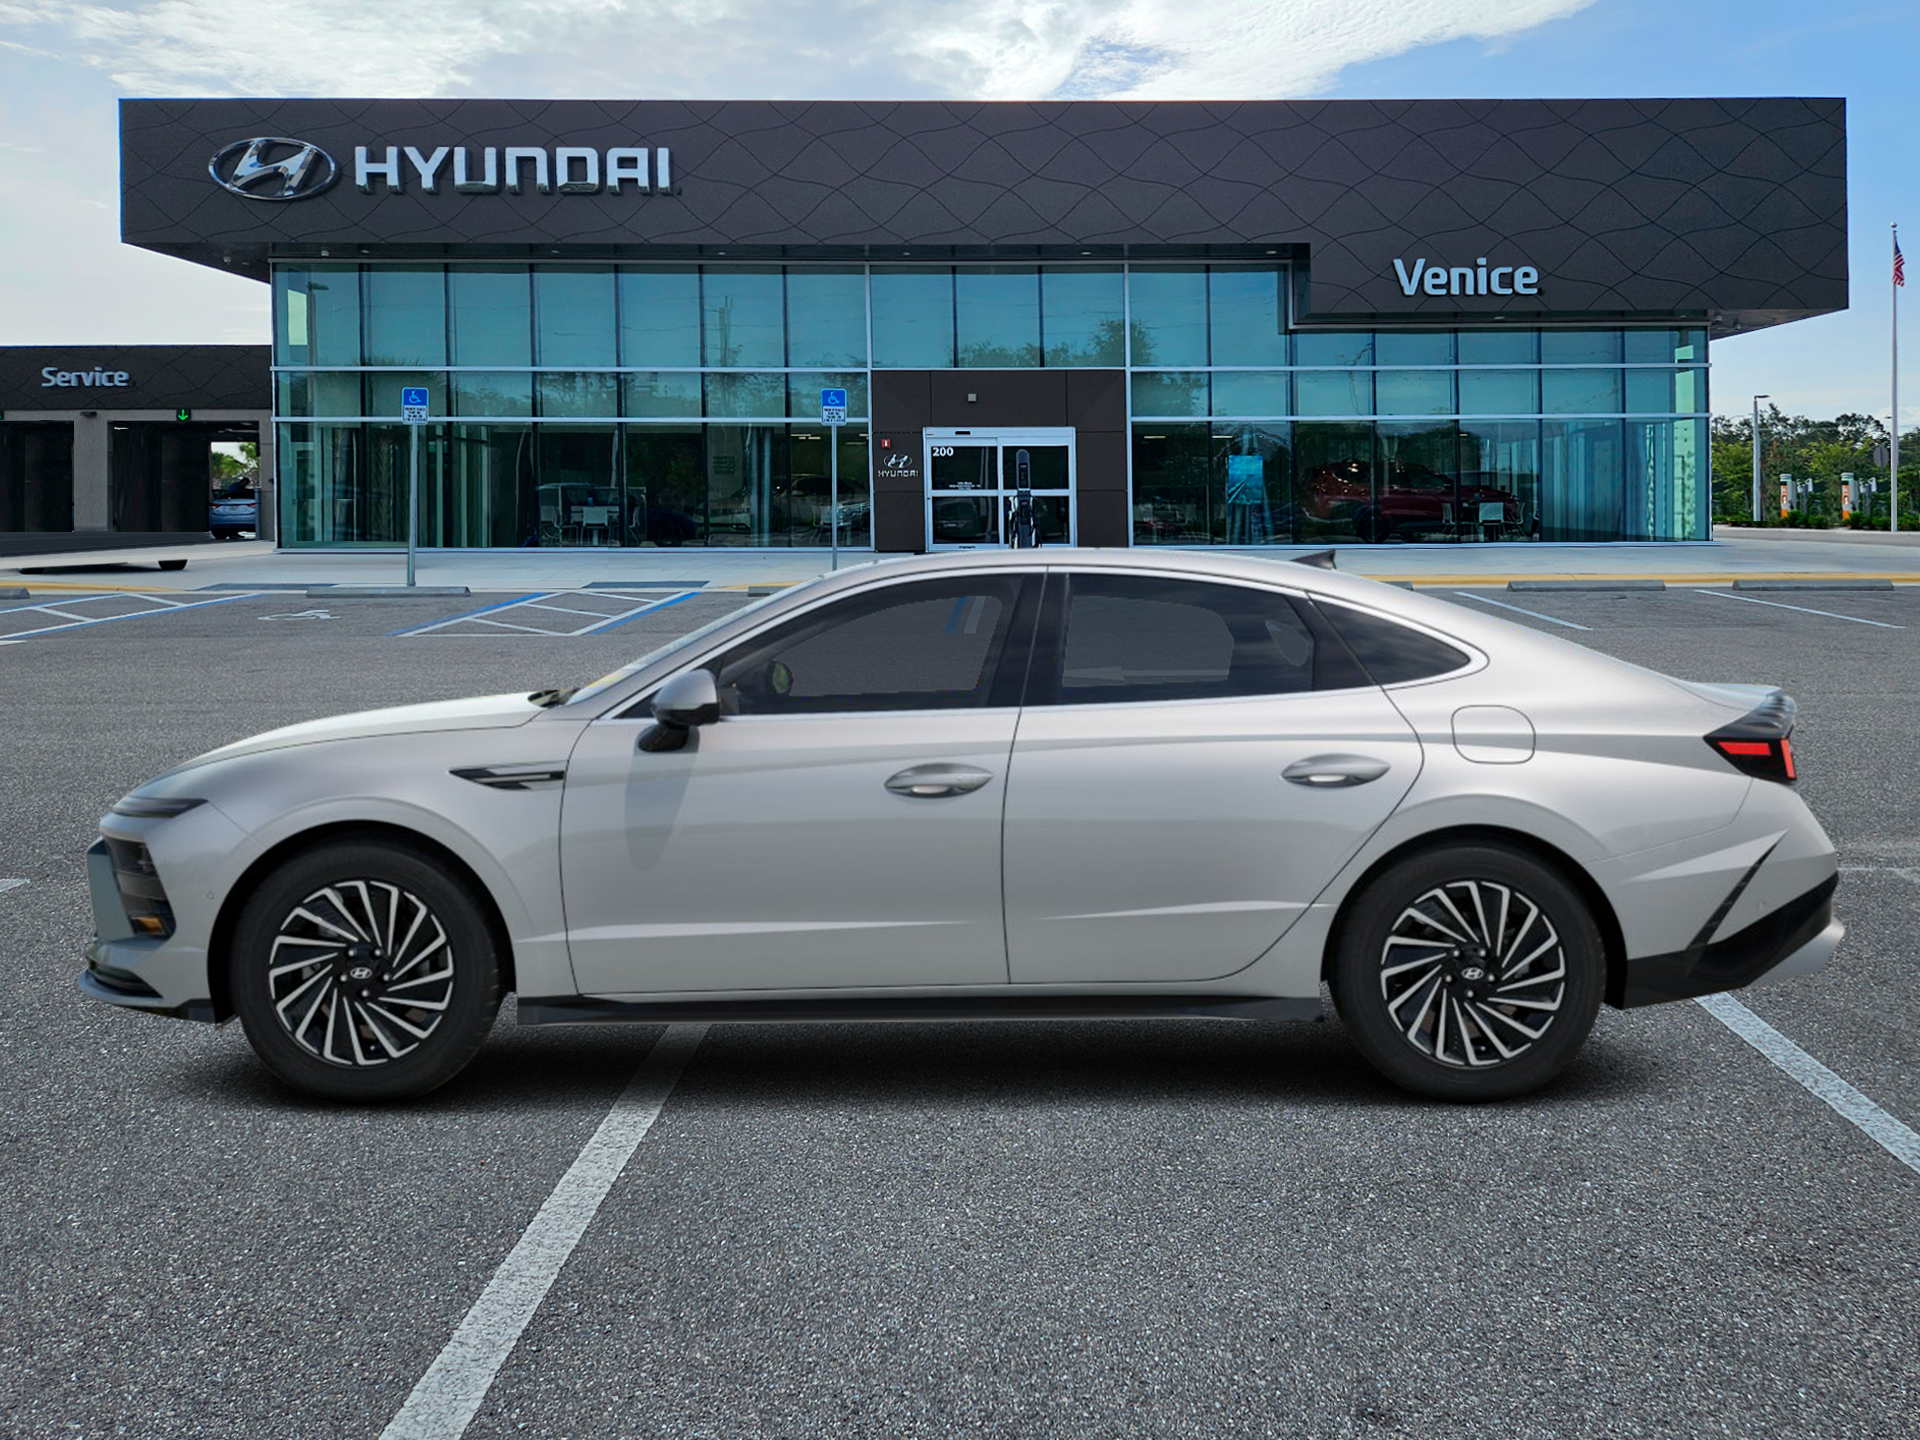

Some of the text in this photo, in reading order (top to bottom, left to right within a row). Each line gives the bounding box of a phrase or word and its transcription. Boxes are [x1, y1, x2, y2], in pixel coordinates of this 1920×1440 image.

[354, 146, 670, 193] HYUNDAI
[1393, 257, 1539, 296] Venice
[41, 366, 130, 387] Service
[932, 446, 954, 457] 200
[878, 470, 919, 478] HYUNDAI
